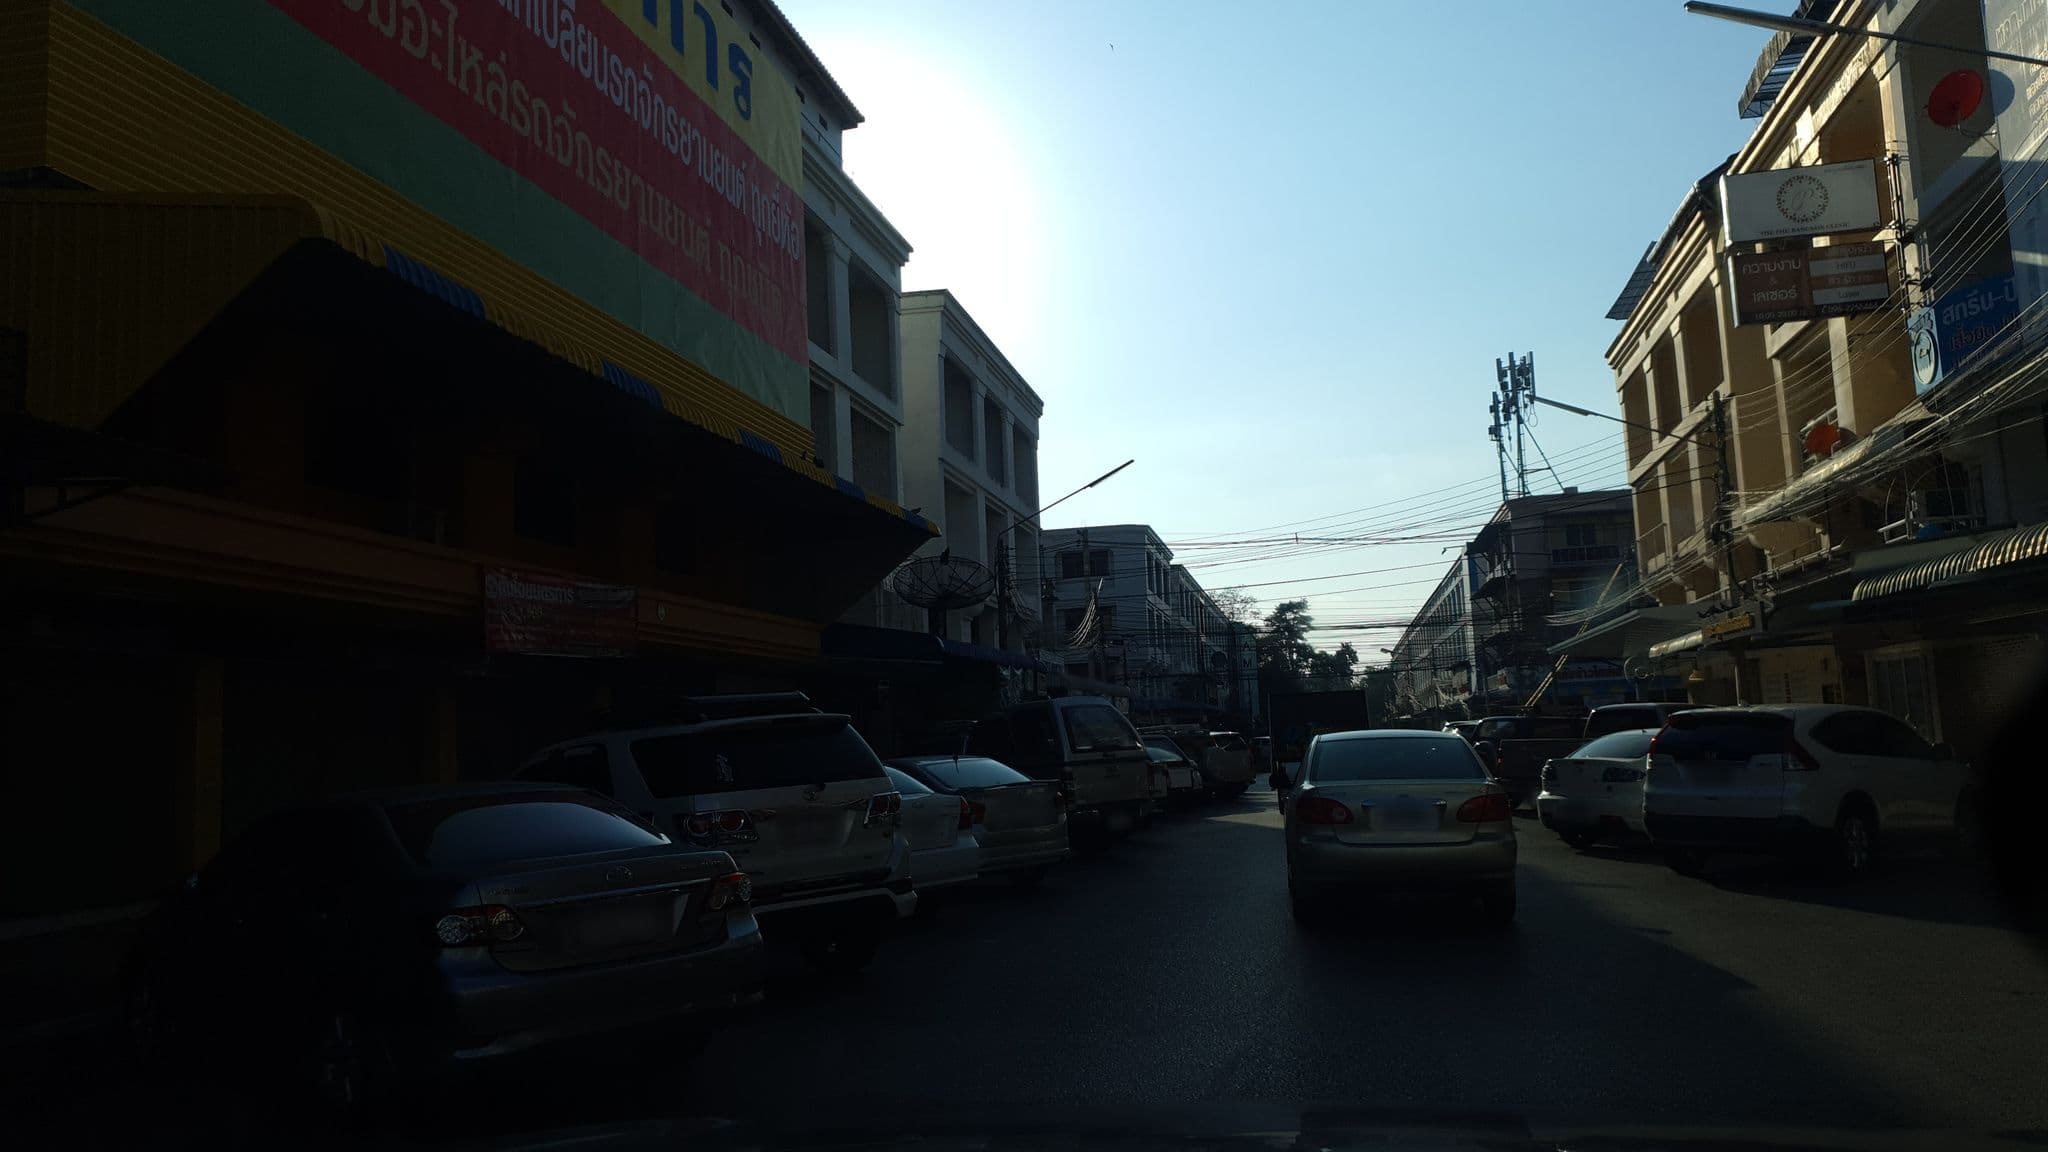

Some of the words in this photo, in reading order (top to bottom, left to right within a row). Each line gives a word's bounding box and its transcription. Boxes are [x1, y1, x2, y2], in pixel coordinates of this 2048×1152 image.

[343, 0, 712, 273] มอะไหล่รถจักรยานยนต์
[1742, 257, 1801, 275] ความงาม
